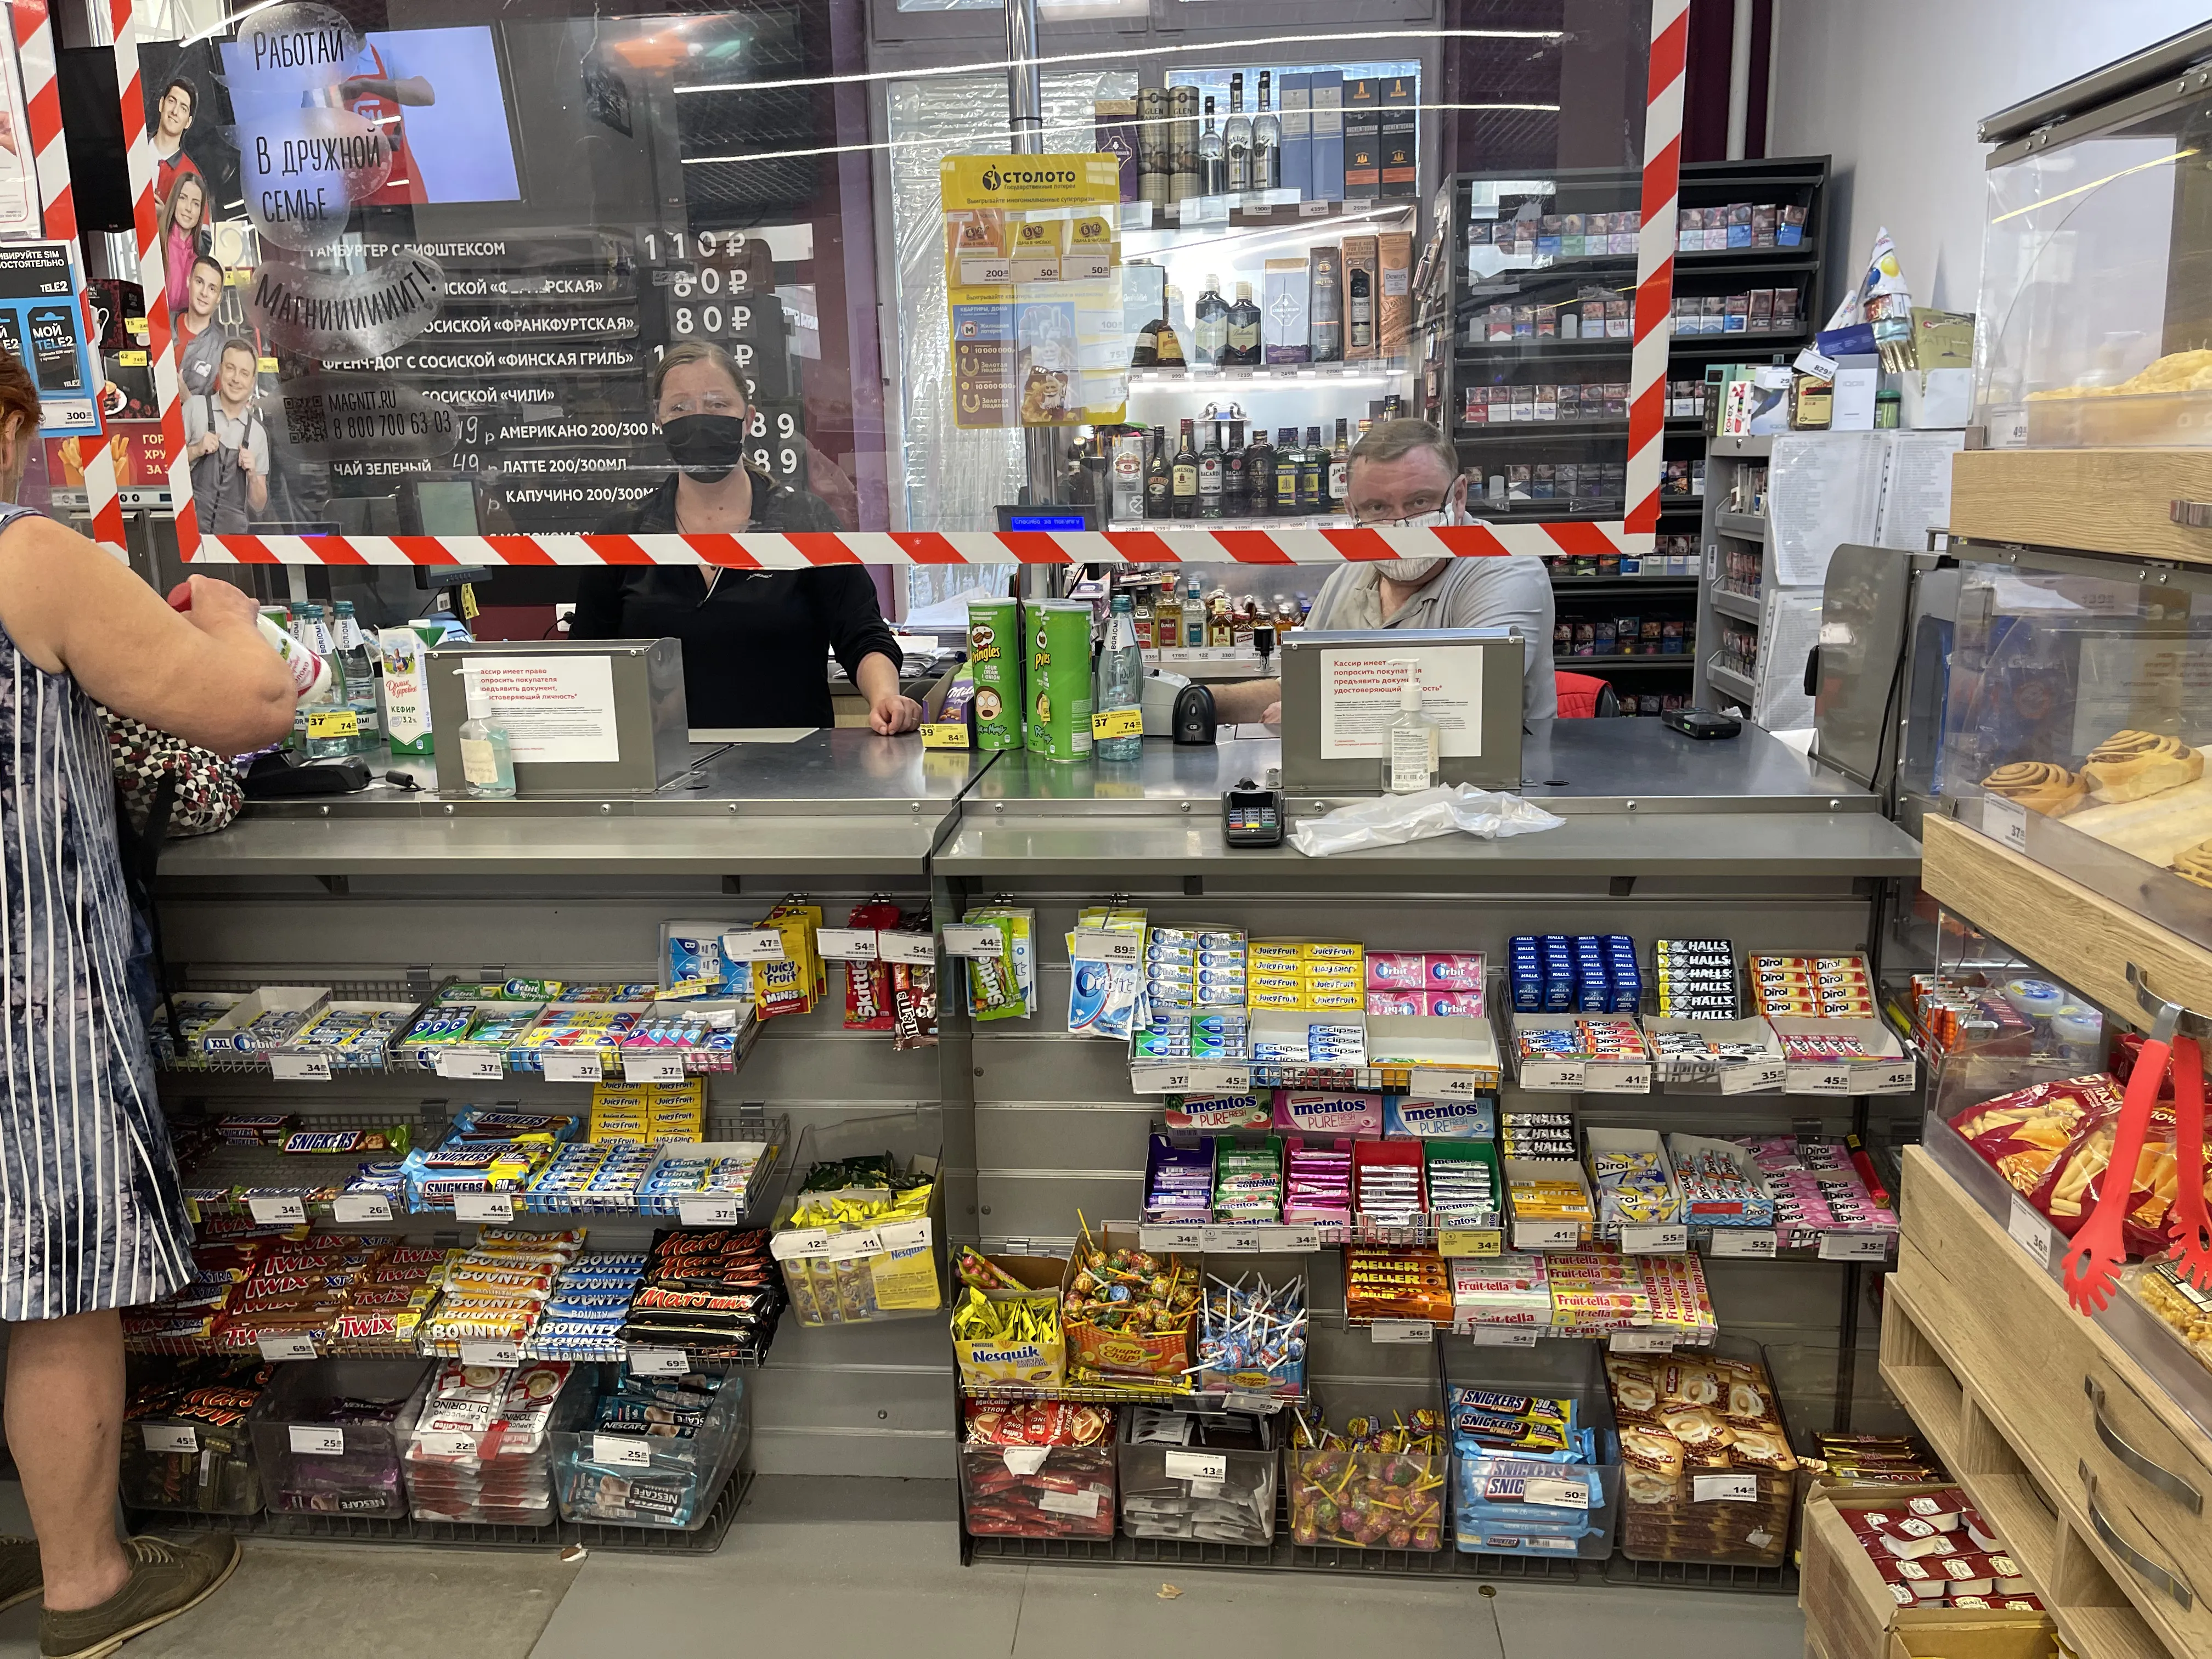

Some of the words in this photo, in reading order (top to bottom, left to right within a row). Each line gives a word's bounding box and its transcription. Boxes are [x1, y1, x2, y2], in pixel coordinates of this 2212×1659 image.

[254, 23, 344, 70] РАБОТАЙ
[256, 136, 271, 175] В
[282, 128, 381, 176] ДРУЖНОЙ
[1003, 171, 1076, 183] СТОЛОТО
[262, 188, 326, 223] СЕМЬЕ
[40, 280, 68, 292] TELE2
[32, 323, 63, 338] МОЙ
[419, 351, 495, 369] СОСИСКОЙ
[1814, 364, 1829, 375] 829
[329, 390, 396, 413] MAGNIT.RU
[334, 418, 341, 439] 8
[348, 416, 374, 438] 800
[382, 414, 404, 437] 700
[410, 413, 428, 435] 63
[500, 423, 588, 439] АМЕРИКАНО
[503, 459, 546, 473] ЛАТТЕ
[506, 488, 583, 504] КАПУЧИНО
[316, 624, 327, 654] BORJOMI
[525, 668, 547, 676] право
[521, 685, 558, 693] документ,
[1334, 686, 1402, 695] удостоверяющий
[310, 718, 324, 726] 37
[1094, 719, 1108, 727] 37
[921, 728, 933, 736] 39
[1114, 945, 1128, 953] 89
[1688, 940, 1729, 952] HALLS
[763, 960, 795, 974] Juicy
[1758, 958, 1782, 968] Dirol
[1375, 962, 1408, 978] Orbit
[766, 970, 797, 986] Fruit
[1076, 966, 1133, 998] Orbit
[1319, 1026, 1362, 1036] eclipse
[211, 1038, 232, 1050] XXL
[234, 1033, 275, 1052] Orbit
[581, 1066, 594, 1075] 37
[1762, 1071, 1776, 1080] 35
[1226, 1076, 1240, 1085] 45
[601, 1097, 619, 1106] Juicy
[620, 1097, 639, 1106] Fruit
[1185, 1096, 1257, 1115] mentos
[1293, 1099, 1367, 1116] mentos
[1308, 1114, 1338, 1127] PURE
[288, 1132, 358, 1150] SNICKERS
[1595, 1161, 1629, 1171] Dirol
[281, 1206, 295, 1214] 34
[1553, 1231, 1568, 1240] 41
[1662, 1234, 1677, 1243] 55
[1352, 1260, 1420, 1272] MELLER
[640, 1288, 710, 1308] Mars
[342, 1316, 395, 1339] Twix
[432, 1324, 512, 1340] BOUNTY
[973, 1346, 1041, 1365] Nesquik
[432, 1400, 473, 1412] TORINO
[1465, 1391, 1525, 1409] SNICKERS
[1203, 1467, 1216, 1475] 13
[1565, 1491, 1579, 1499] 50
[1733, 1486, 1747, 1494] 14
